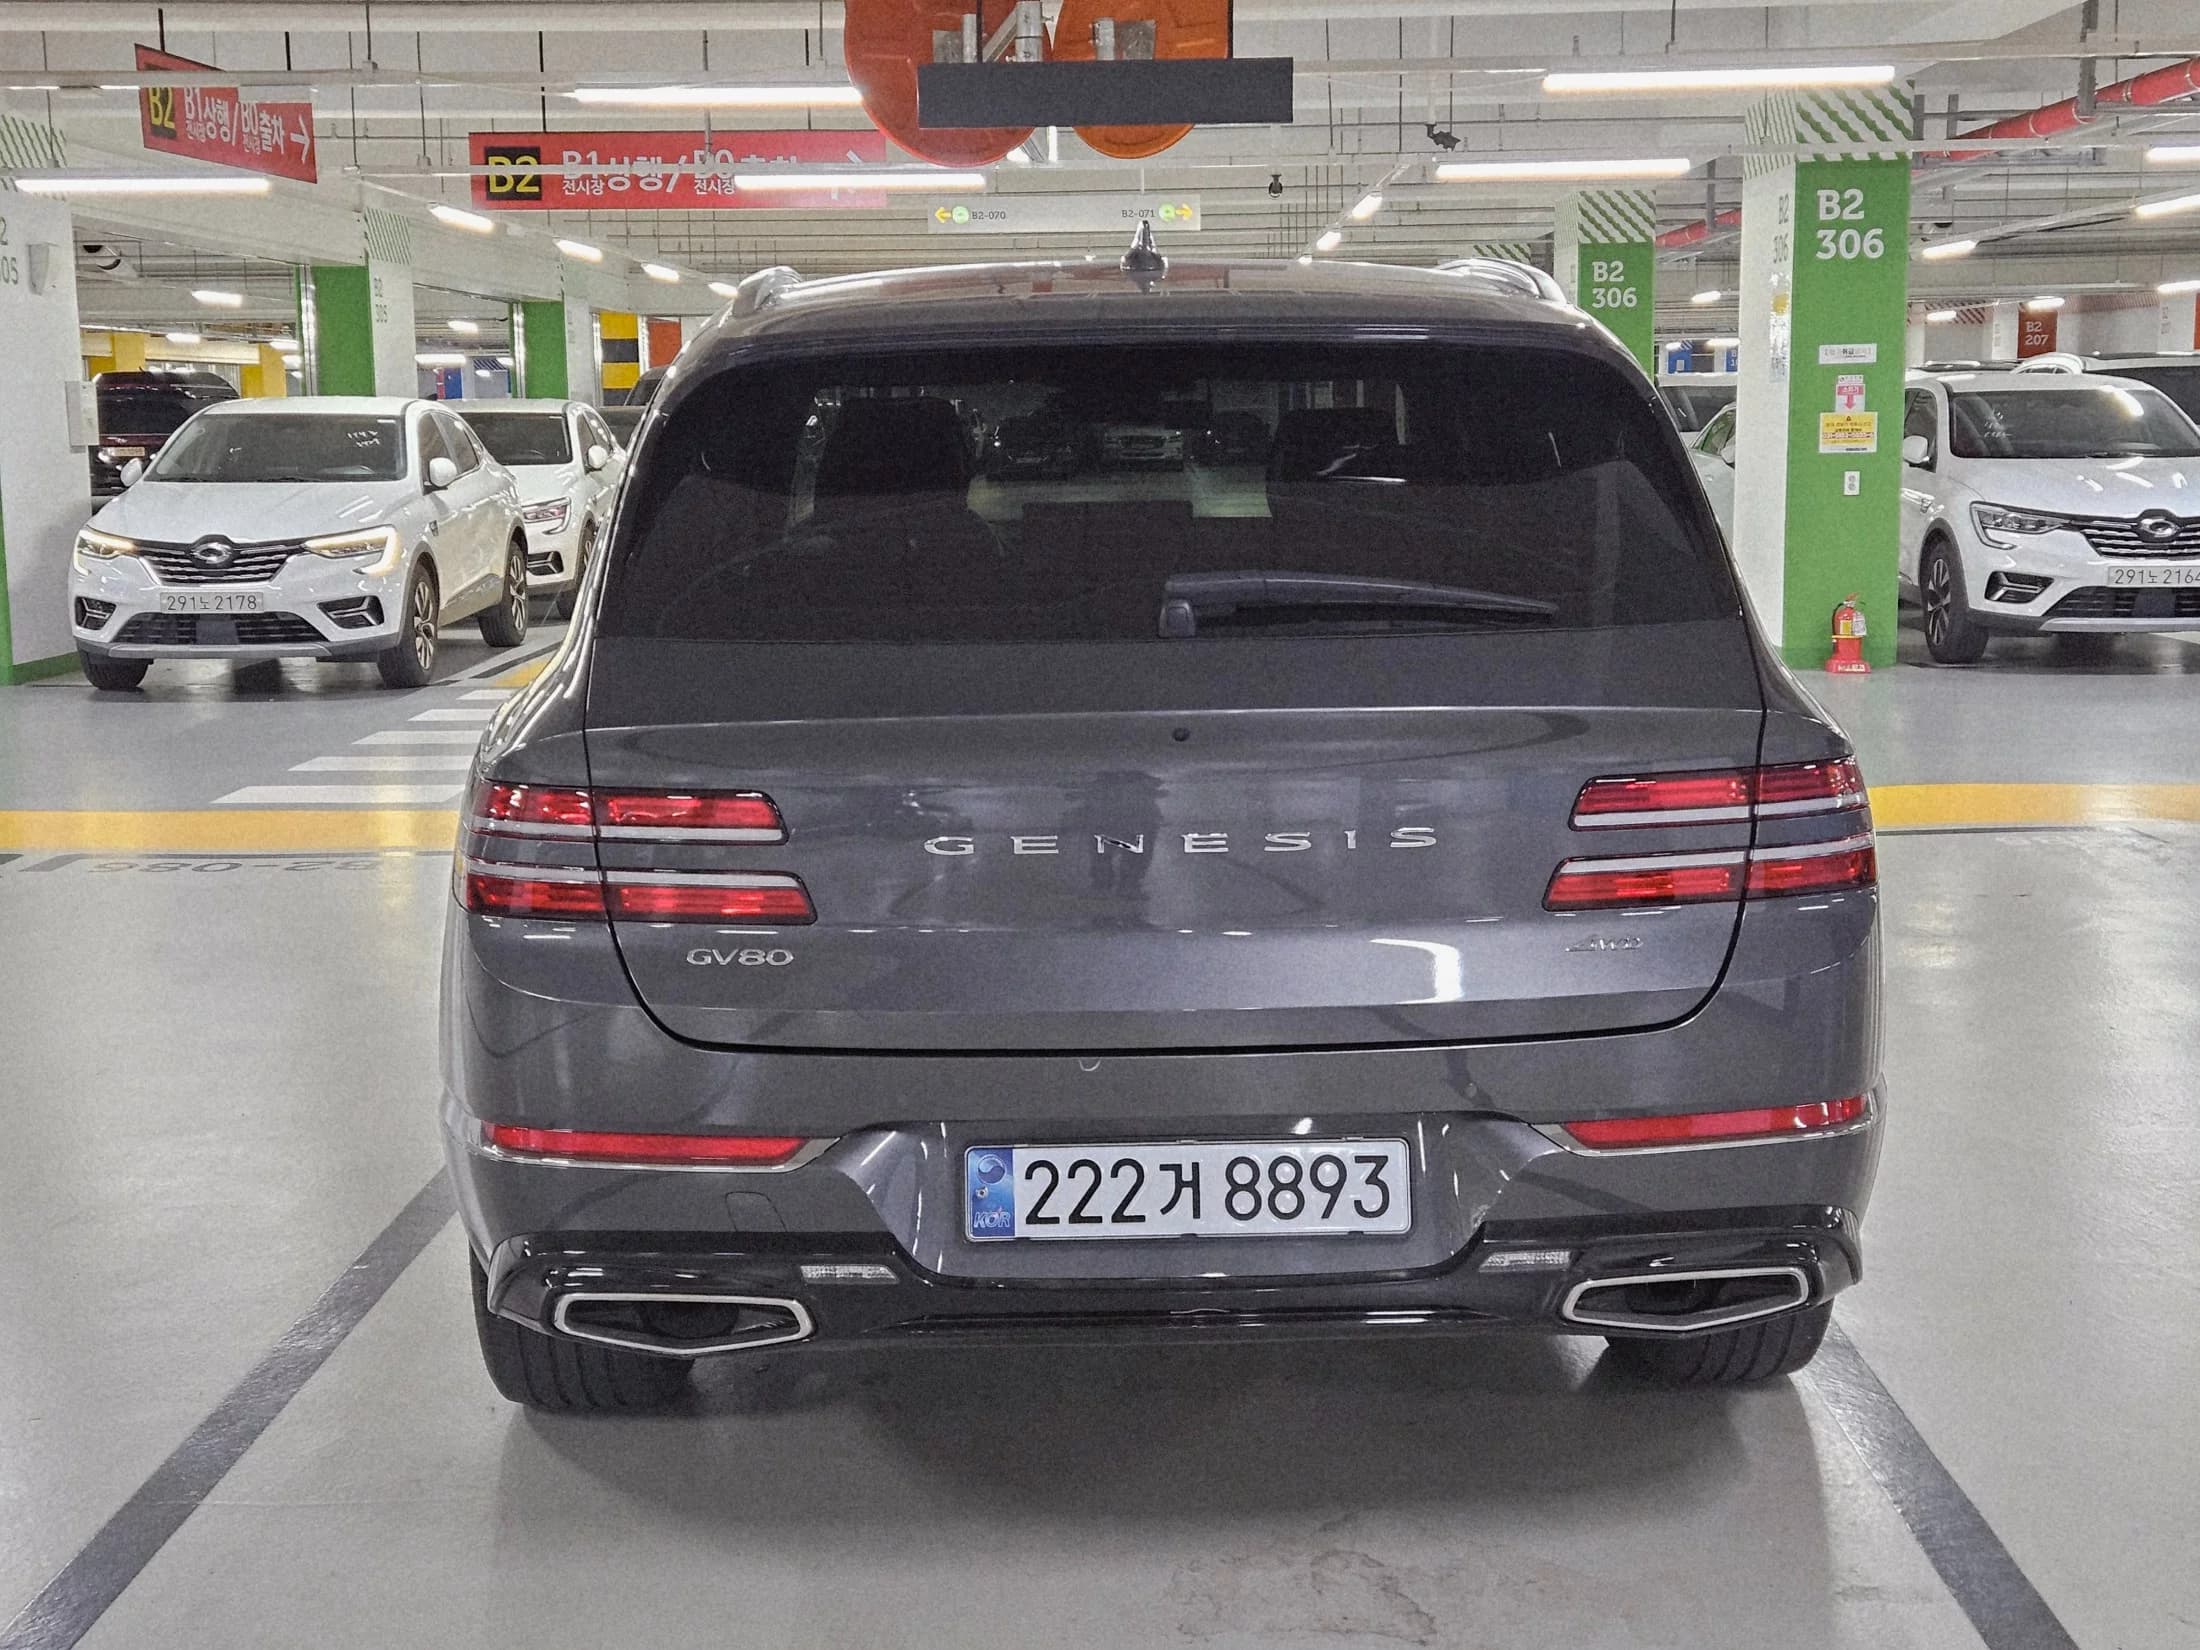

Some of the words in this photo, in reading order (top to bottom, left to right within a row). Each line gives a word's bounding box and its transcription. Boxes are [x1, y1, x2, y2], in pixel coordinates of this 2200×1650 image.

[149, 87, 175, 129] B2
[488, 155, 541, 193] B2
[562, 179, 605, 195] 전시장
[1121, 208, 1156, 219] B2-071
[1816, 188, 1865, 221] B2
[971, 210, 1007, 221] B2-070
[1815, 227, 1885, 260] 306
[1592, 261, 1625, 282] B2
[1591, 286, 1638, 308] 306
[2025, 321, 2042, 332] B2
[2024, 334, 2049, 345] 207
[2114, 568, 2158, 585] 291노
[167, 595, 211, 611] 291노
[214, 594, 258, 610] 2178
[923, 826, 1438, 856] GENESIS
[686, 948, 795, 966] GV80
[1024, 1157, 1201, 1225] 222거
[1224, 1154, 1391, 1222] 8893
[973, 1210, 1011, 1229] KOR
